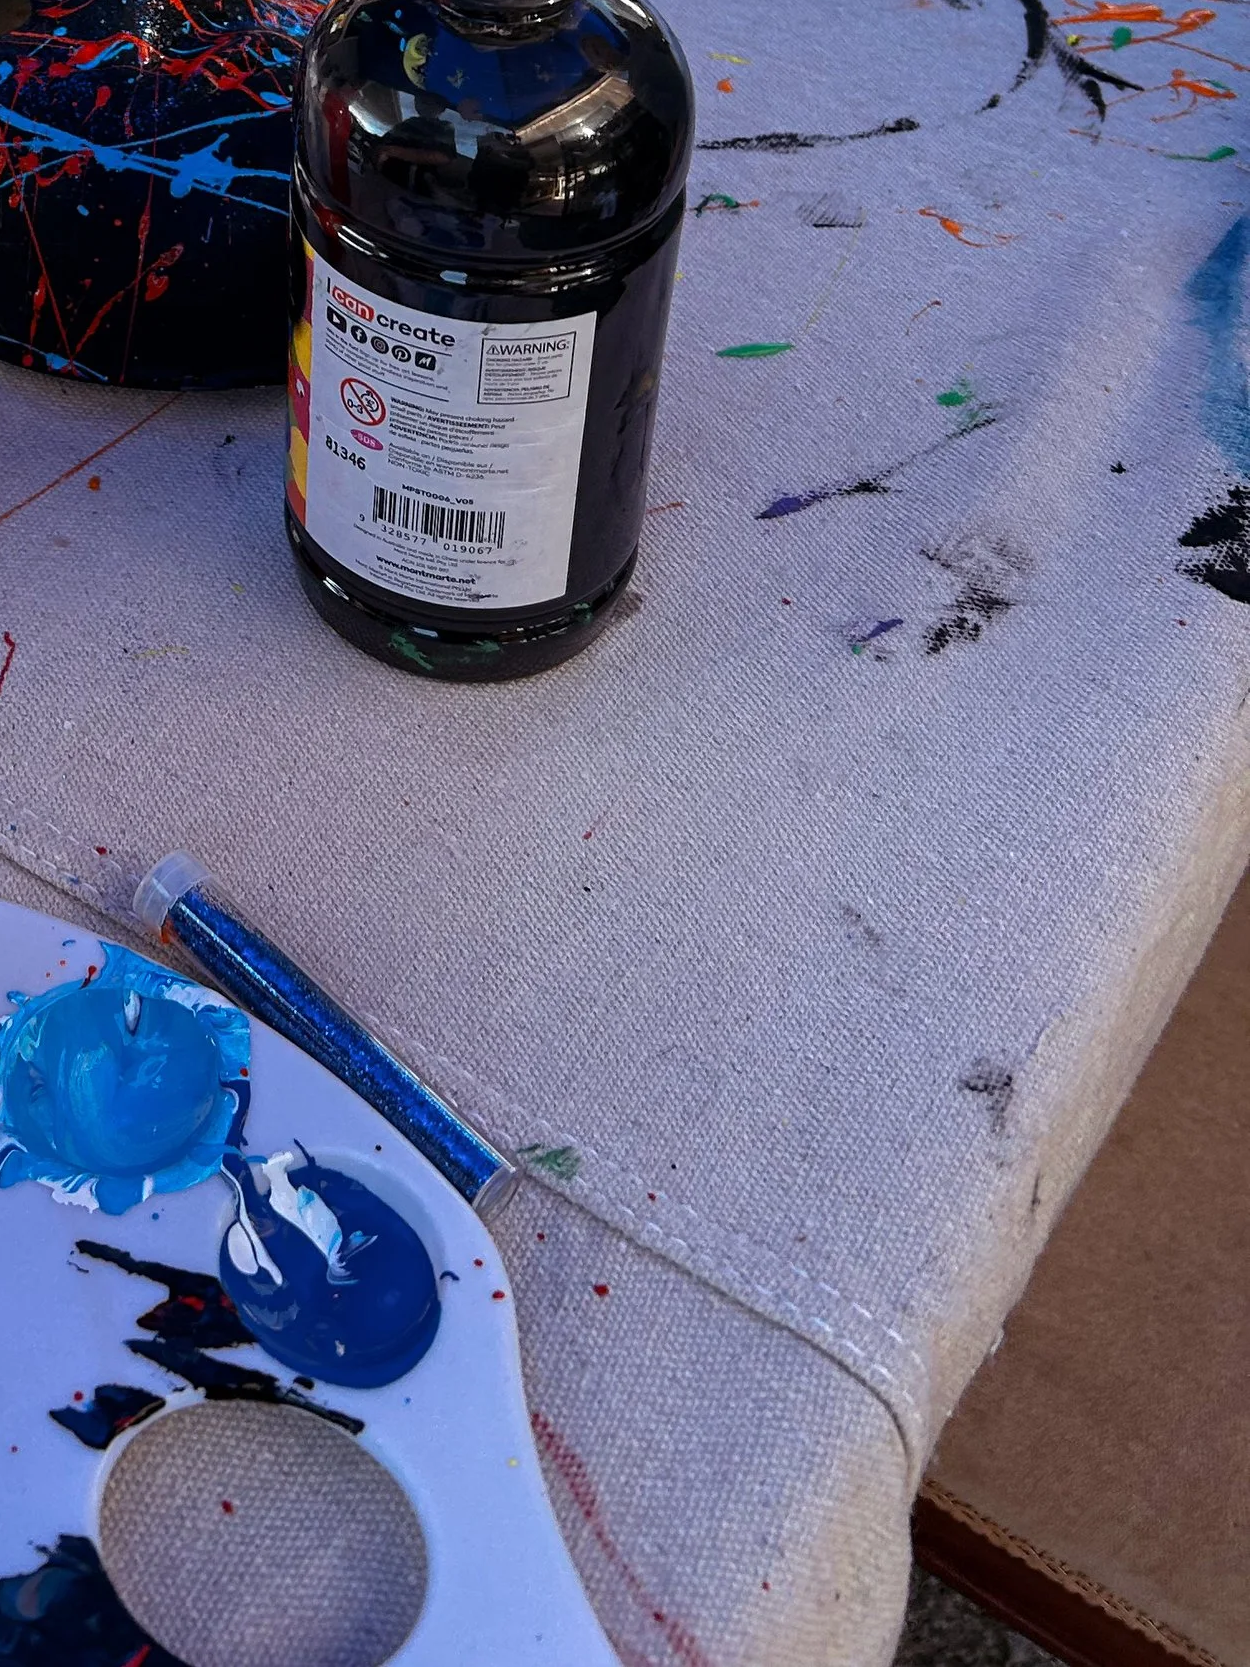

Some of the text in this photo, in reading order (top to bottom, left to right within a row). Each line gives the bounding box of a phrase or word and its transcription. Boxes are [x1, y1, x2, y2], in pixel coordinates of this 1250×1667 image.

[327, 277, 456, 347] I can create
[499, 339, 570, 355] WARNING:
[325, 434, 366, 471] 81346
[359, 513, 493, 555] 9 328577 019067
[375, 554, 476, 585] www.montmarte.net
